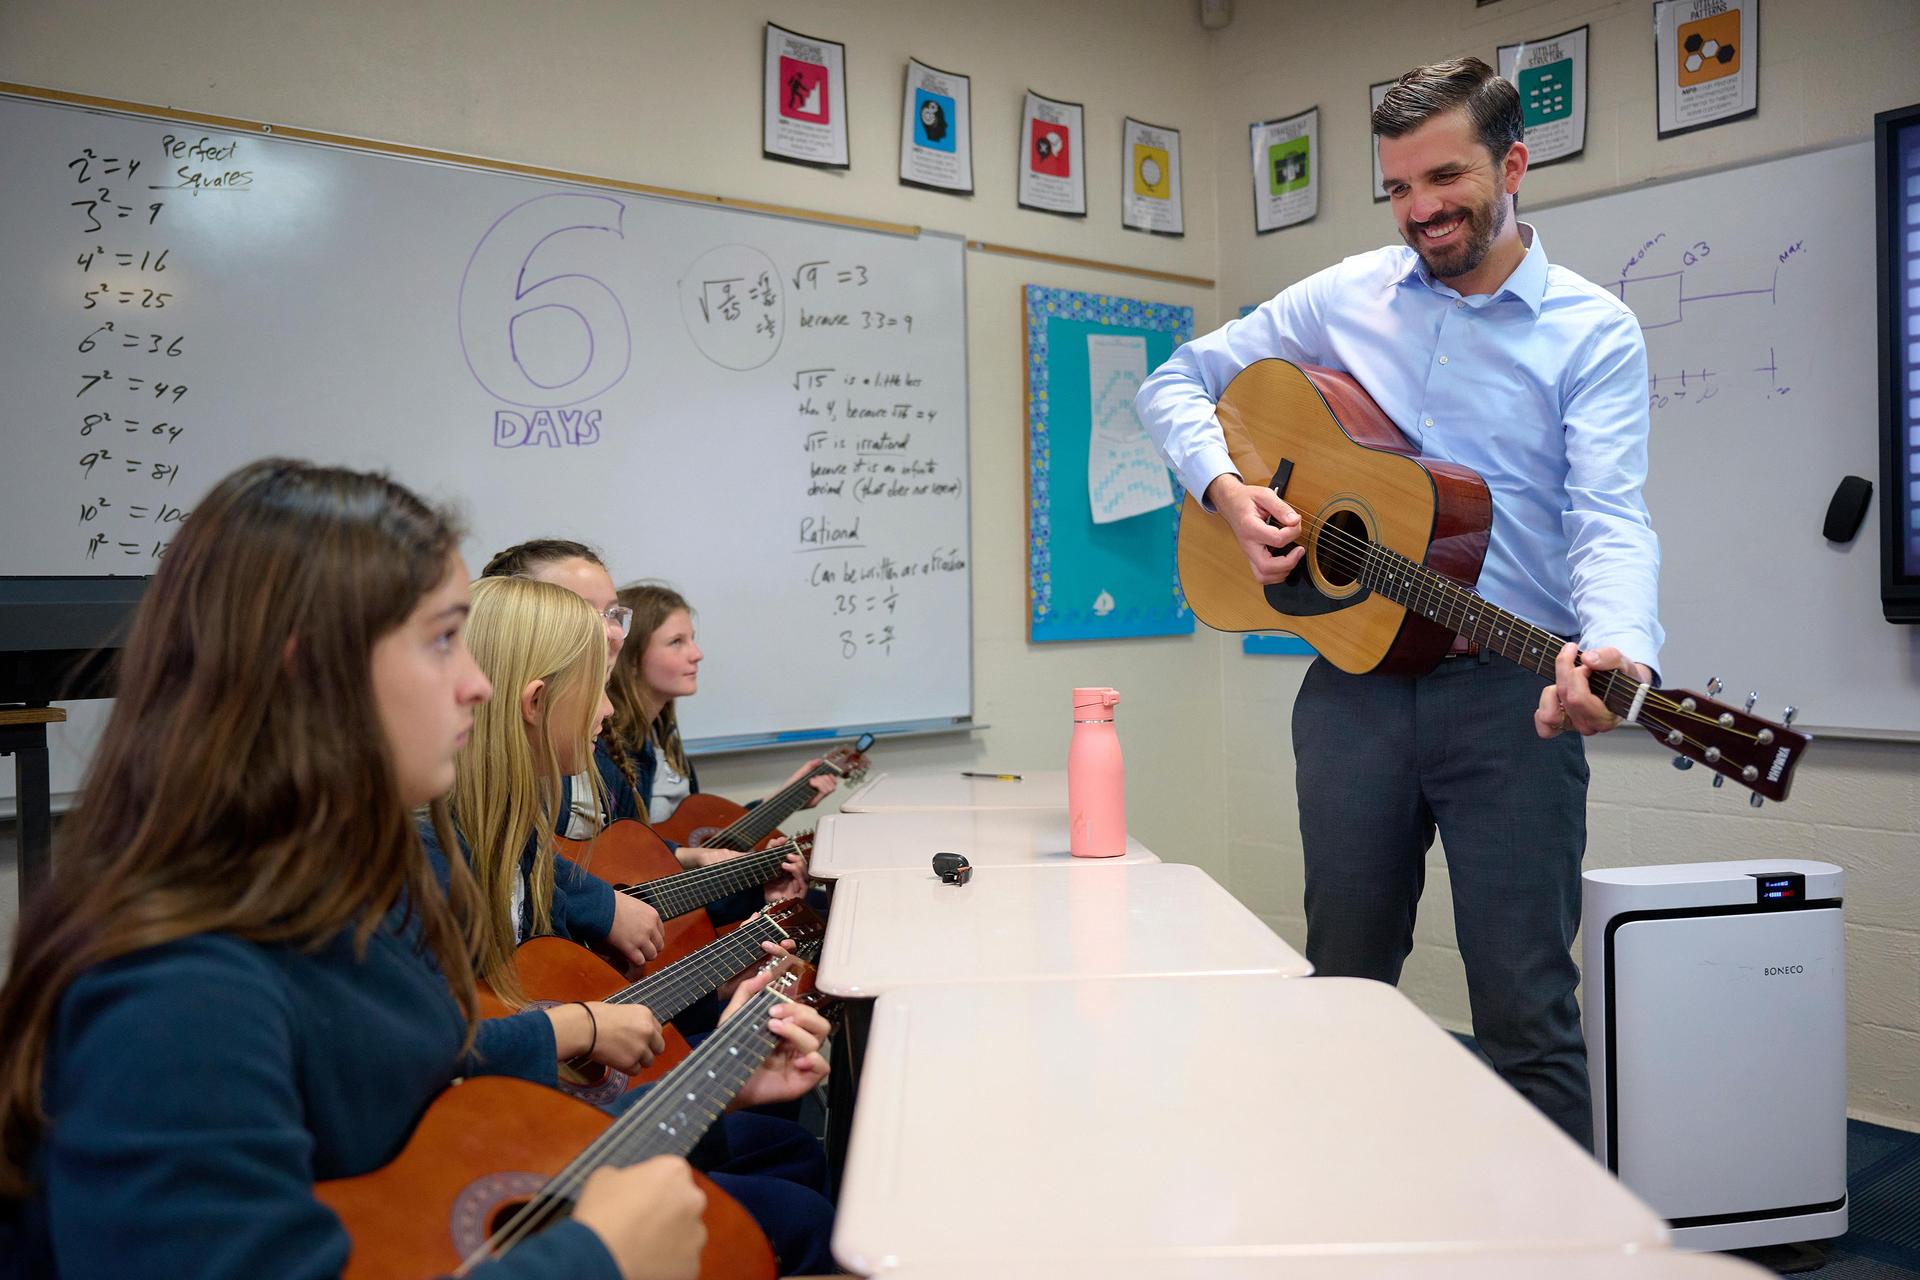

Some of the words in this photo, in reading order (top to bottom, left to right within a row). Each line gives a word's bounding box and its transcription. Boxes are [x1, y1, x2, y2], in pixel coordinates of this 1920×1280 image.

[162, 135, 237, 162] Perfect
[176, 165, 255, 198] Squares
[456, 192, 634, 410] 6
[800, 308, 849, 328] because
[492, 409, 603, 449] DAYS
[799, 514, 862, 546] Rational
[1764, 964, 1804, 976] BONECO
